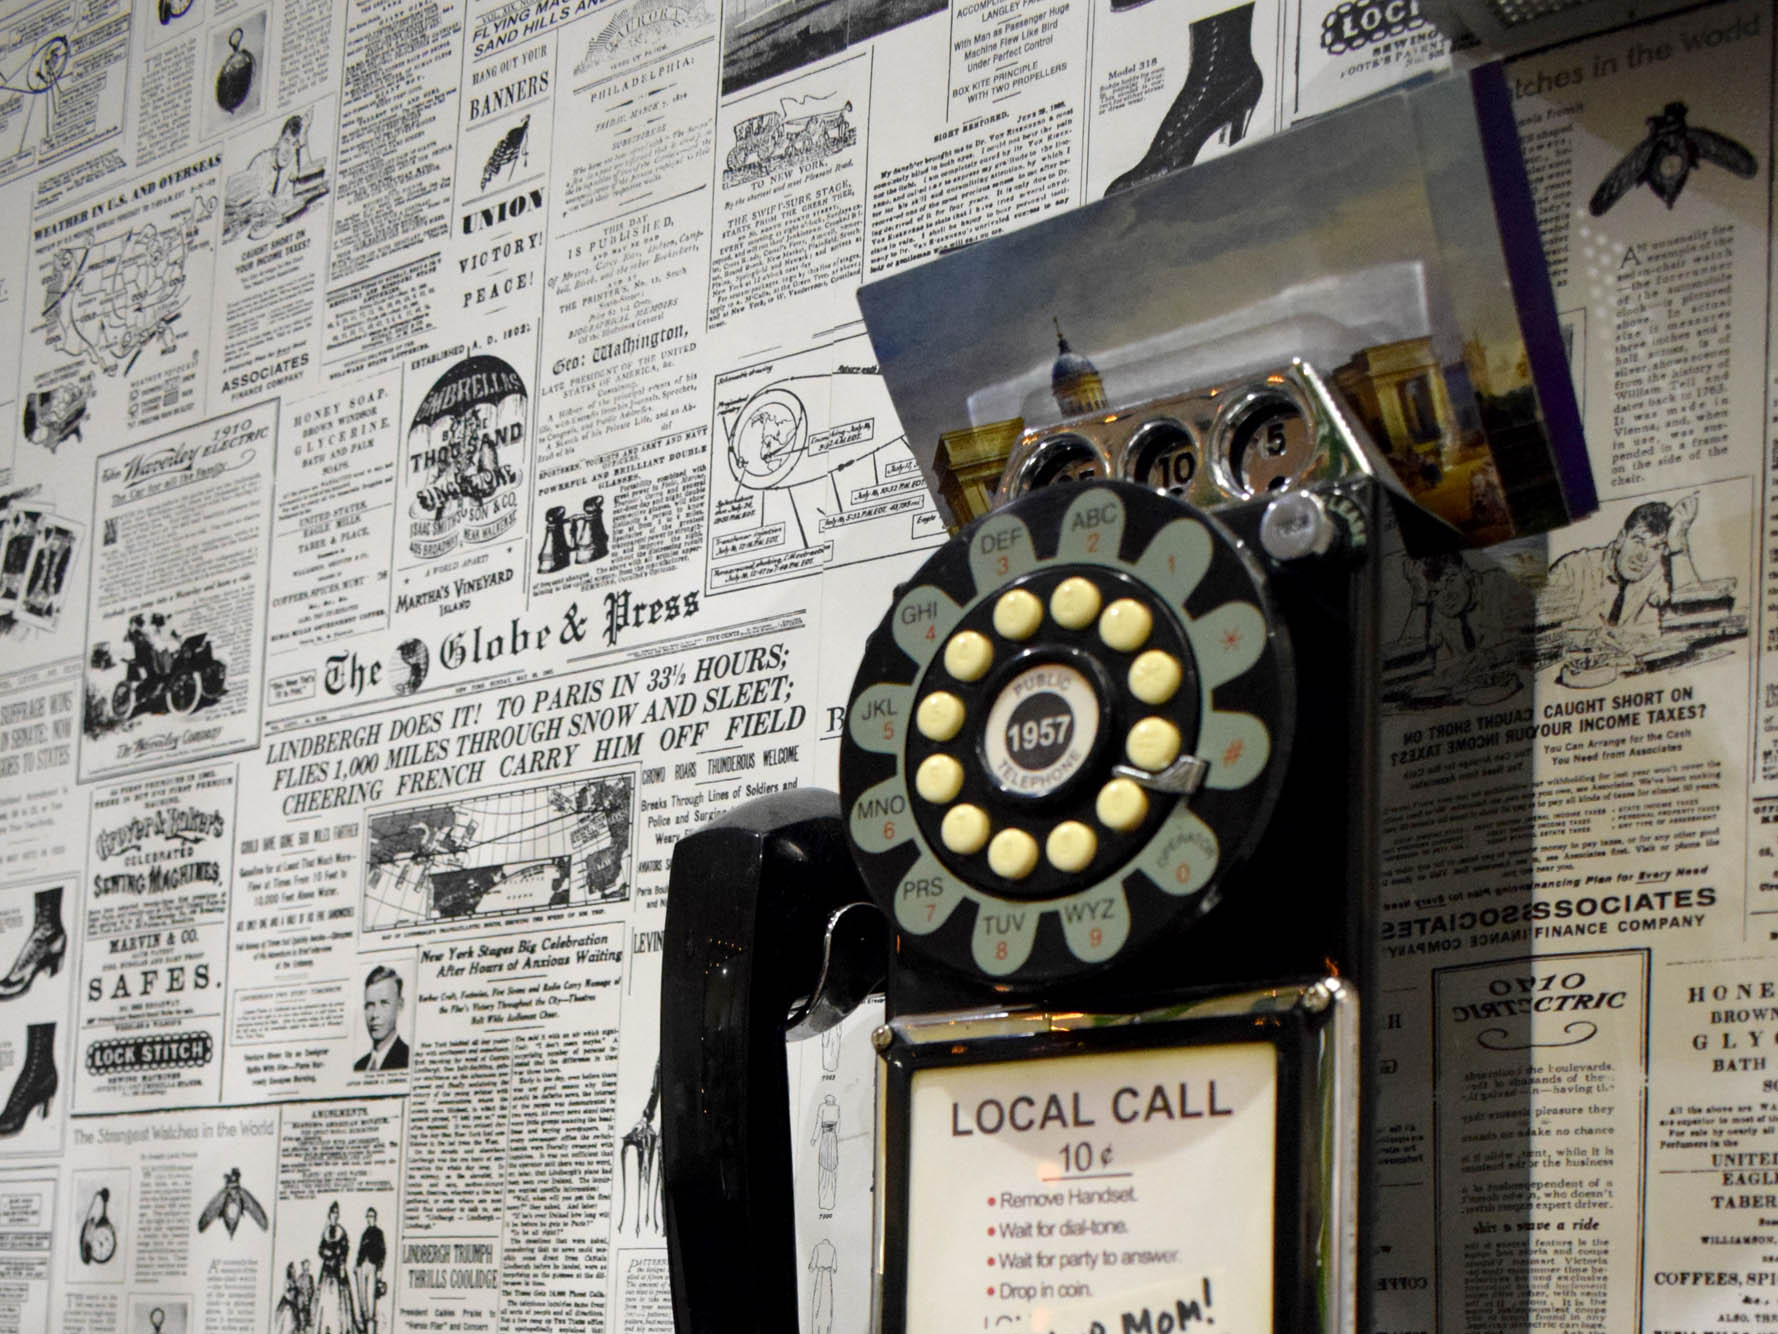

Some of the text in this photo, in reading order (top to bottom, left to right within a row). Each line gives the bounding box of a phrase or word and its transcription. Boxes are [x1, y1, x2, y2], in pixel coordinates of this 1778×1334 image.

[953, 3, 1070, 51] With Man Passenger Huge
[964, 20, 1058, 60] Machine Flew Like Bird
[1593, 54, 1619, 78] in
[1627, 39, 1672, 67] the
[469, 71, 549, 121] BANNERS
[461, 188, 546, 235] UNION
[457, 231, 544, 275] VICTORY!
[462, 271, 535, 309] PEACE!
[222, 353, 310, 394] ASSOCIATES
[1267, 423, 1286, 455] 5
[1159, 453, 1195, 488] 10
[1072, 504, 1118, 531] ABC
[981, 529, 1022, 554] DEF
[1087, 533, 1098, 553] 2
[998, 556, 1008, 574] 3
[1169, 555, 1176, 572] 1
[396, 568, 513, 613] MARTHA'S VINEYARD
[902, 602, 937, 625] GHI
[324, 589, 701, 696] The Globe & Press
[925, 626, 936, 641] 4
[1012, 671, 1073, 695] PUBLIC
[266, 723, 382, 765] LINDBERGH
[389, 711, 443, 741] DOES
[451, 703, 483, 729] IT!
[497, 694, 525, 720] TO
[532, 679, 604, 713] PARIS
[610, 672, 640, 699] IN
[693, 643, 790, 683] HOURS;
[861, 699, 898, 720] JKL
[1544, 686, 1692, 719] CAUGHT SHORT ON
[883, 723, 894, 740] 5
[1579, 703, 1707, 733] INCOME TAXES?
[273, 675, 794, 791] FLIES 1,000 MILES THROUGH SNOW AND SLEET;
[1007, 714, 1071, 752] 1957
[283, 705, 806, 816] CHEERING FRENCH CARRY HIM OFF FIELD
[998, 749, 1081, 790] TELEPHONE
[857, 796, 905, 818] MNO
[884, 822, 894, 840] 6
[1176, 864, 1189, 883] 0
[903, 877, 943, 900] PRS
[926, 905, 936, 921] 7
[983, 913, 1025, 935] TUV
[1064, 899, 1115, 923] WYZ
[1618, 914, 1705, 932] COMPANY
[421, 933, 608, 963] New York Stages Big Celebration
[1090, 928, 1101, 947] 9
[437, 949, 623, 978] After Hours of Anxious Waiting
[995, 943, 1007, 960] 8
[88, 963, 222, 1001] SAFES.
[953, 1081, 1233, 1137] LOCAL CALL
[1000, 1186, 1138, 1208] Remove Handset.
[999, 1218, 1128, 1238] Wait for dial-tone.
[999, 1249, 1180, 1271] Wait for party to answer.
[1000, 1282, 1093, 1302] Drop in coin.
